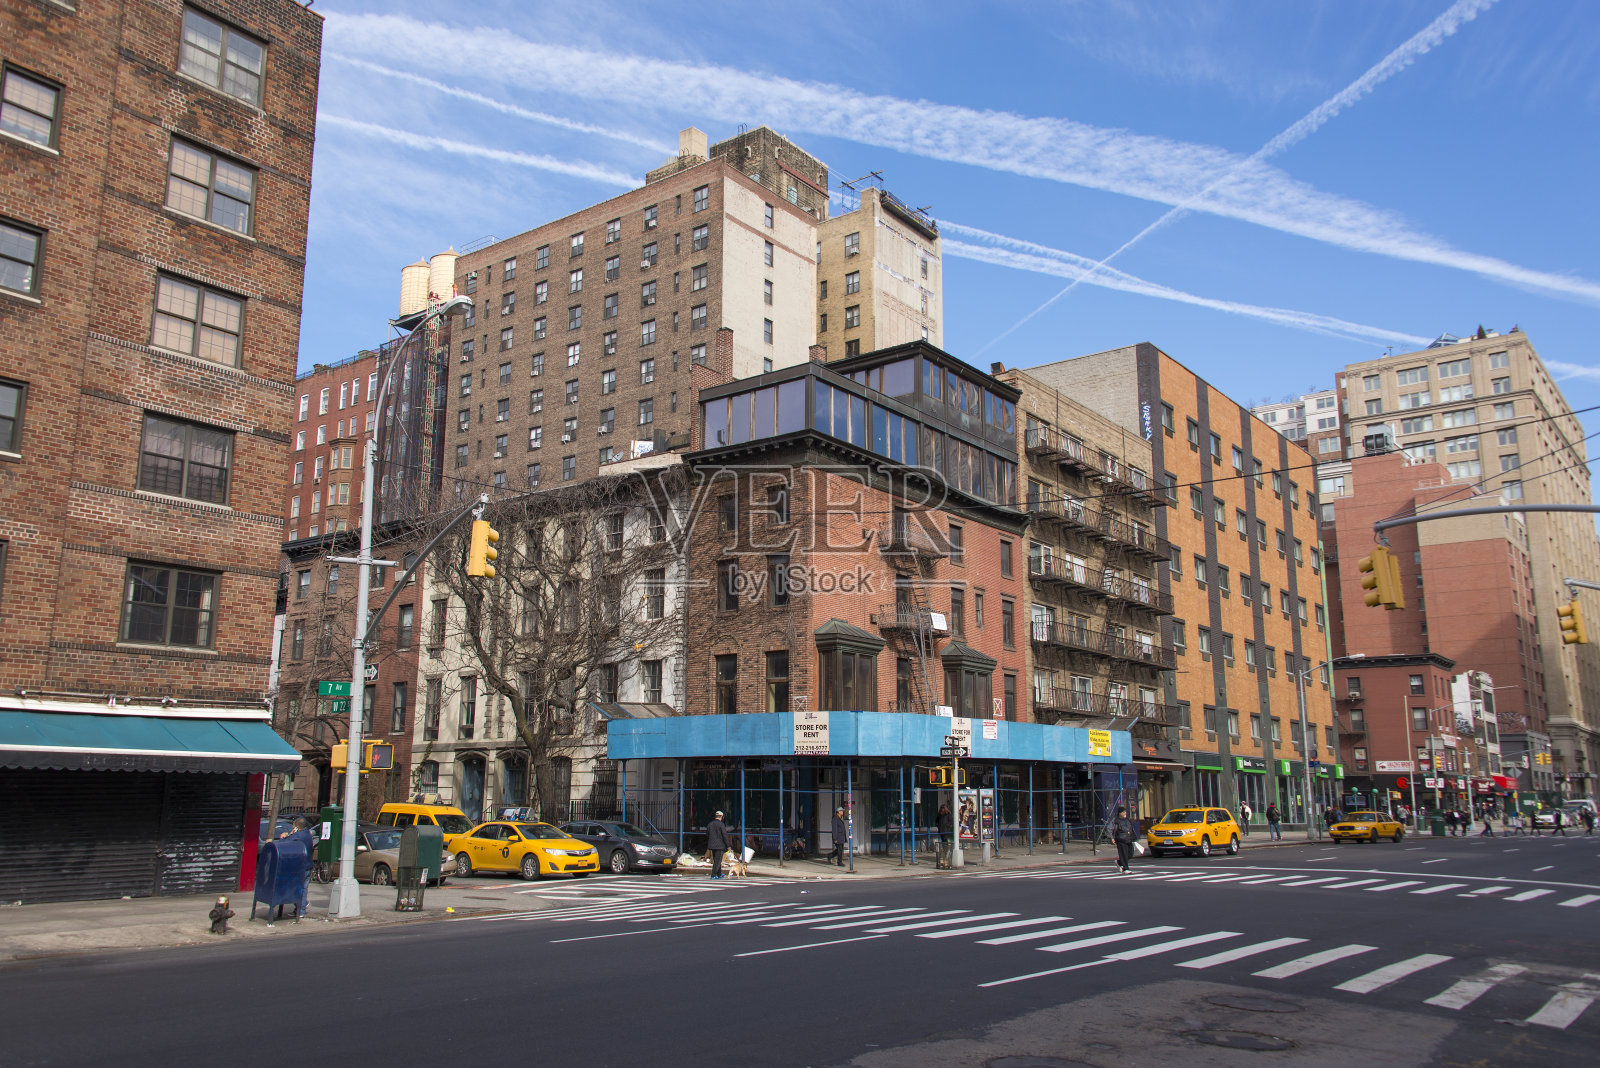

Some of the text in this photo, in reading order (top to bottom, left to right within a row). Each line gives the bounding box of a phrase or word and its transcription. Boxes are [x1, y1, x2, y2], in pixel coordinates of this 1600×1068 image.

[328, 683, 333, 694] 7
[333, 701, 338, 712] W
[339, 700, 346, 711] 22
